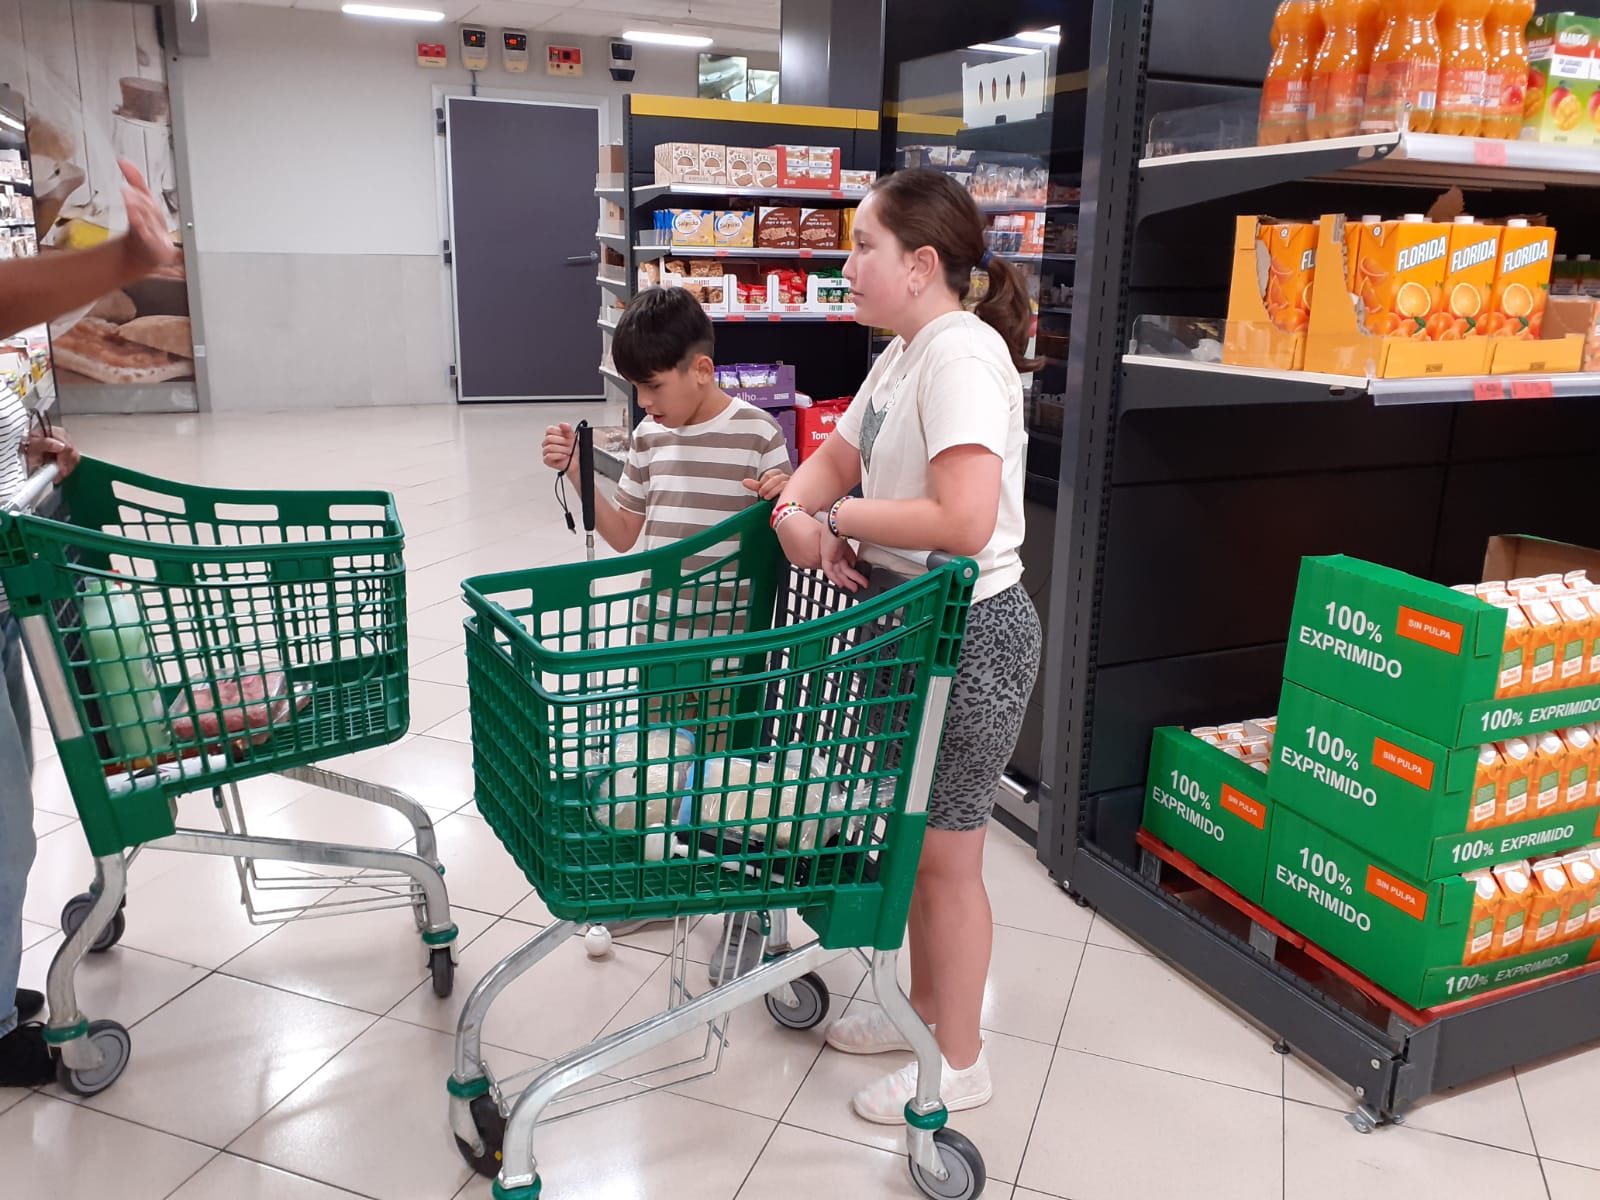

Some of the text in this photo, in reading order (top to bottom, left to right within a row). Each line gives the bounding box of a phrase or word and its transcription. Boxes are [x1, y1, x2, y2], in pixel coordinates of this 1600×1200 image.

[1397, 235, 1446, 272] FLORIDA
[1451, 238, 1496, 273] FLORIDA
[1502, 240, 1549, 273] FLORIDA
[736, 392, 756, 401] Alho
[811, 431, 830, 440] Tom
[1325, 601, 1383, 643] 100%
[1408, 619, 1451, 640] SIN PULPA
[1299, 626, 1402, 679] EXPRIMIDO
[1481, 698, 1600, 731] 100% EXPRIMIDO
[1306, 726, 1359, 771] 100%
[1383, 751, 1423, 775] SIN PULPA
[1170, 770, 1211, 811] 100%
[1281, 746, 1377, 806] EXPRIMIDO
[1152, 786, 1225, 841] EXPRIMIDO
[1452, 825, 1574, 863] 100% EXPRIMIDO
[1300, 847, 1353, 895] 100%
[1276, 864, 1371, 932] EXPRIMIDO
[1376, 878, 1416, 905] SIN PULPA
[1446, 953, 1569, 994] 100% EXPRIMIDO
